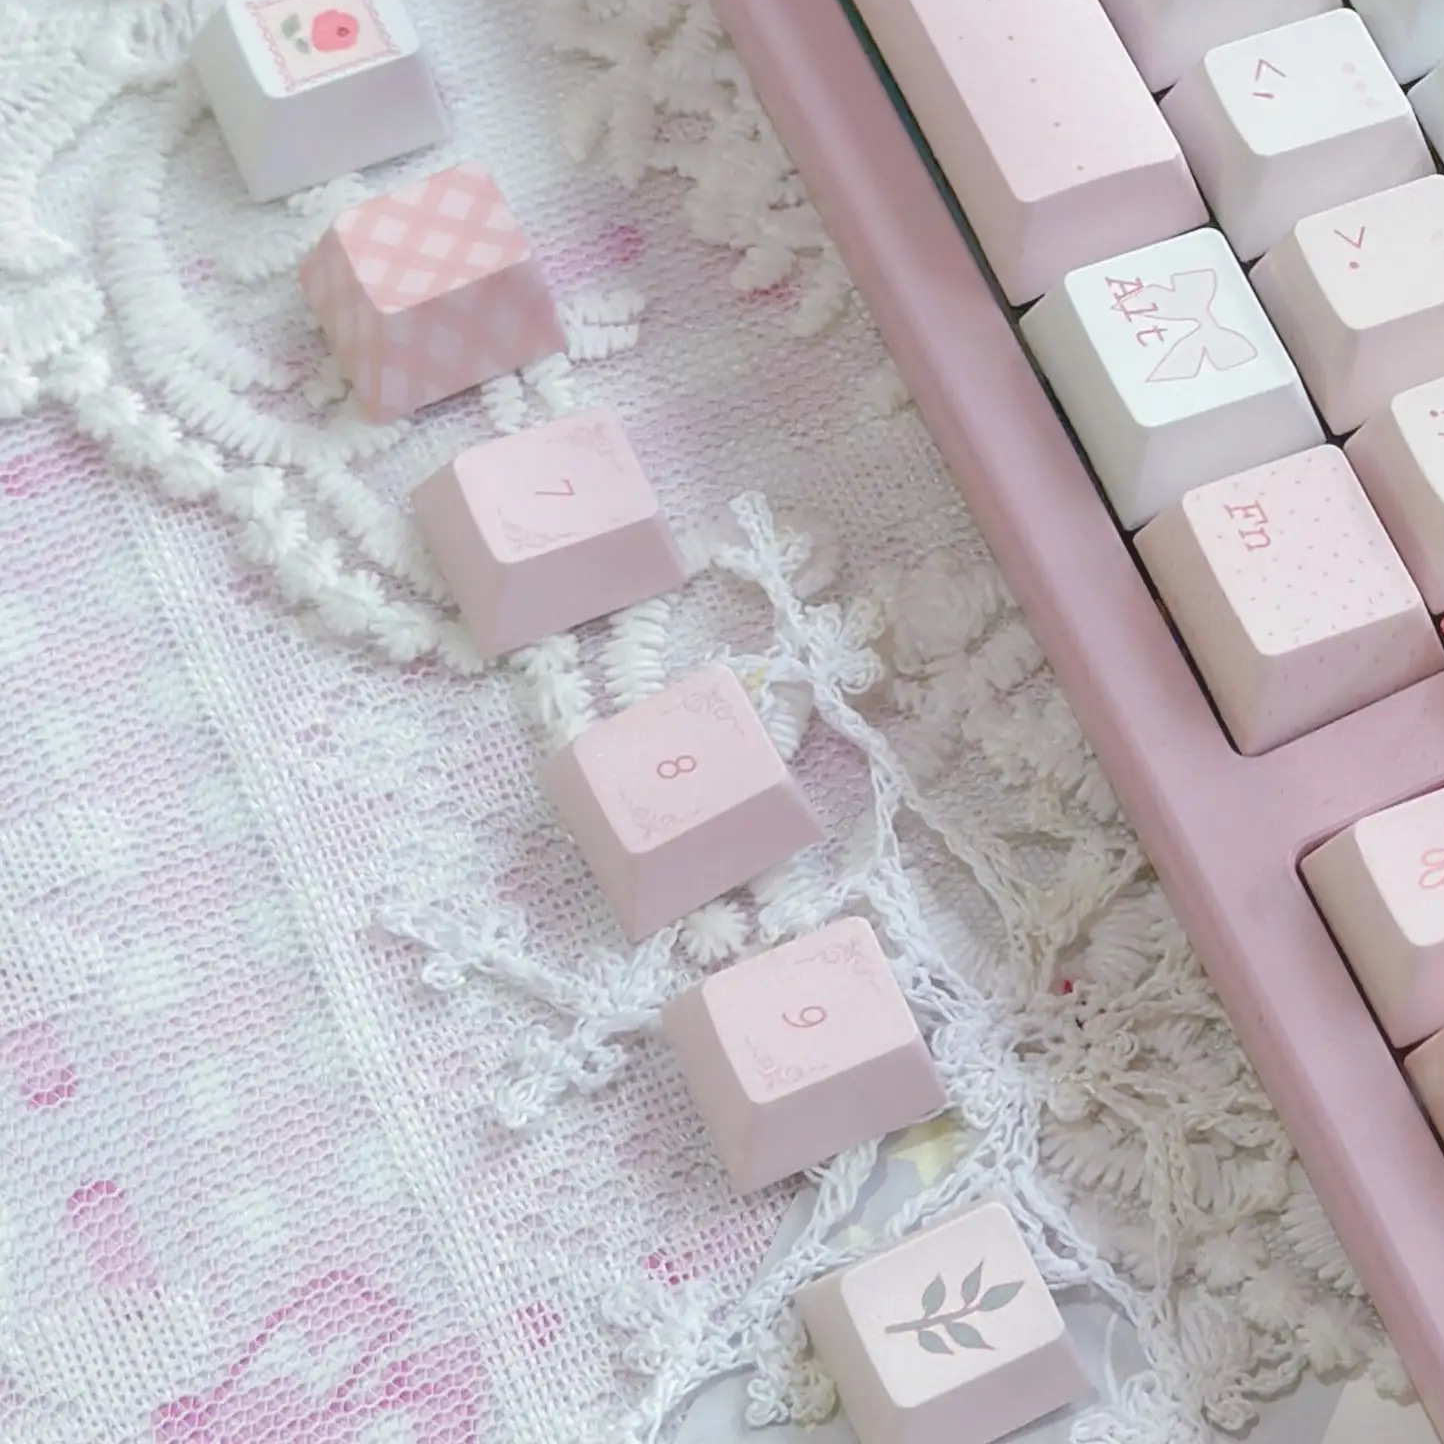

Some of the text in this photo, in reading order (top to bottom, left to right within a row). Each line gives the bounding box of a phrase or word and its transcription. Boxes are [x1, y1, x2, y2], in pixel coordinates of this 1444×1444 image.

[1104, 275, 1168, 348] Alt
[535, 479, 575, 496] 7
[1223, 500, 1272, 552] Fn
[657, 755, 697, 780] 8
[782, 1005, 828, 1028] 9
